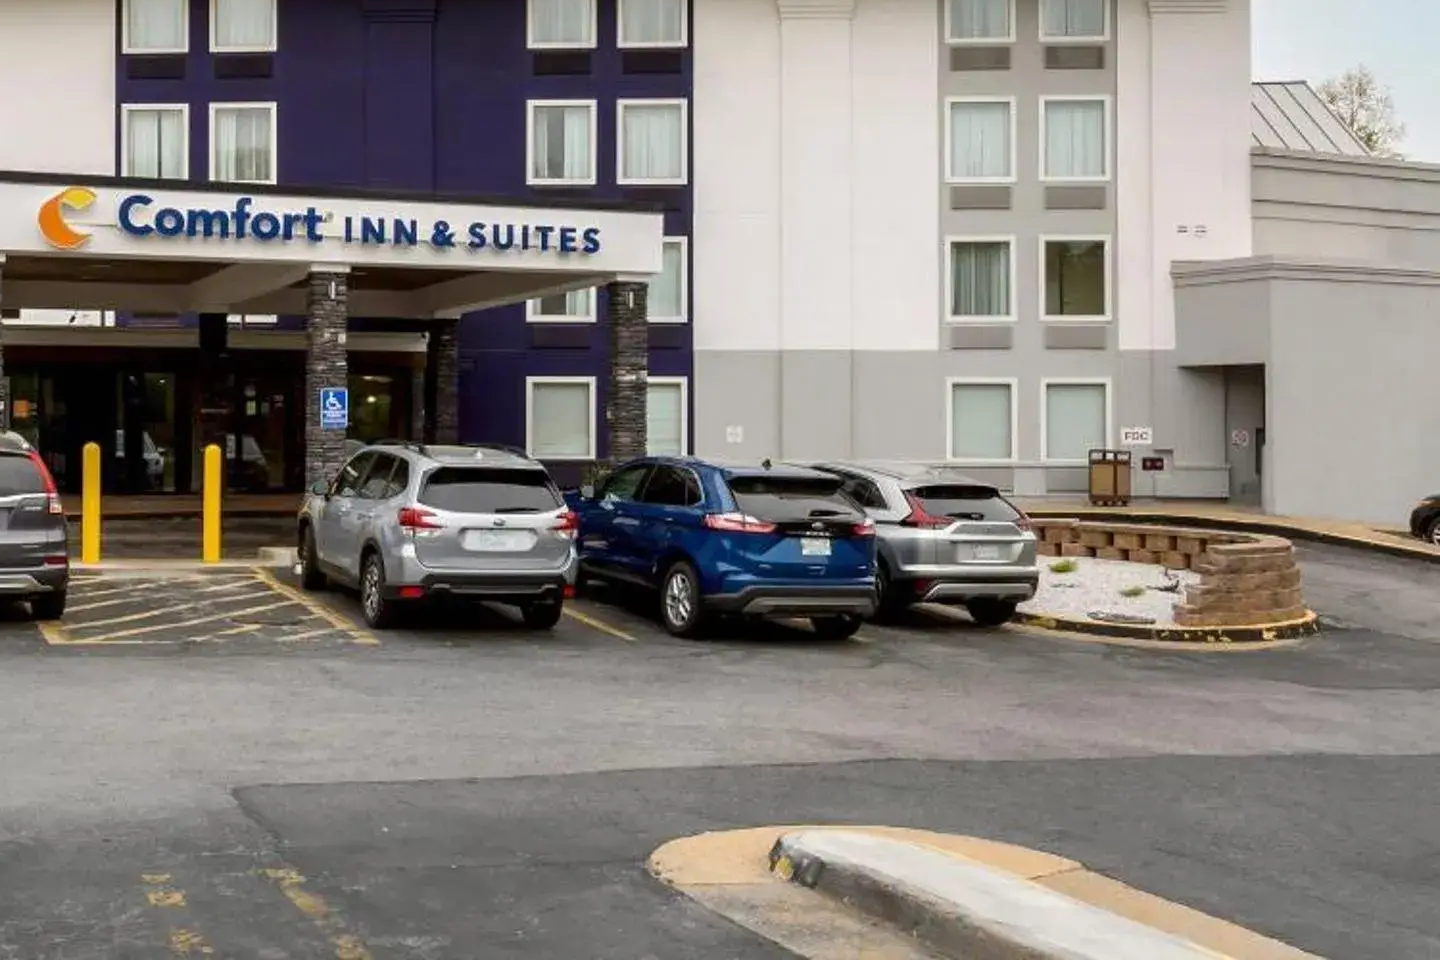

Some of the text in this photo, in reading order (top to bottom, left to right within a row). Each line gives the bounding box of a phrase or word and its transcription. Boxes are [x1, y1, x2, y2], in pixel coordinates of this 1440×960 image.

[118, 194, 601, 254] Comfort INN & SUITES
